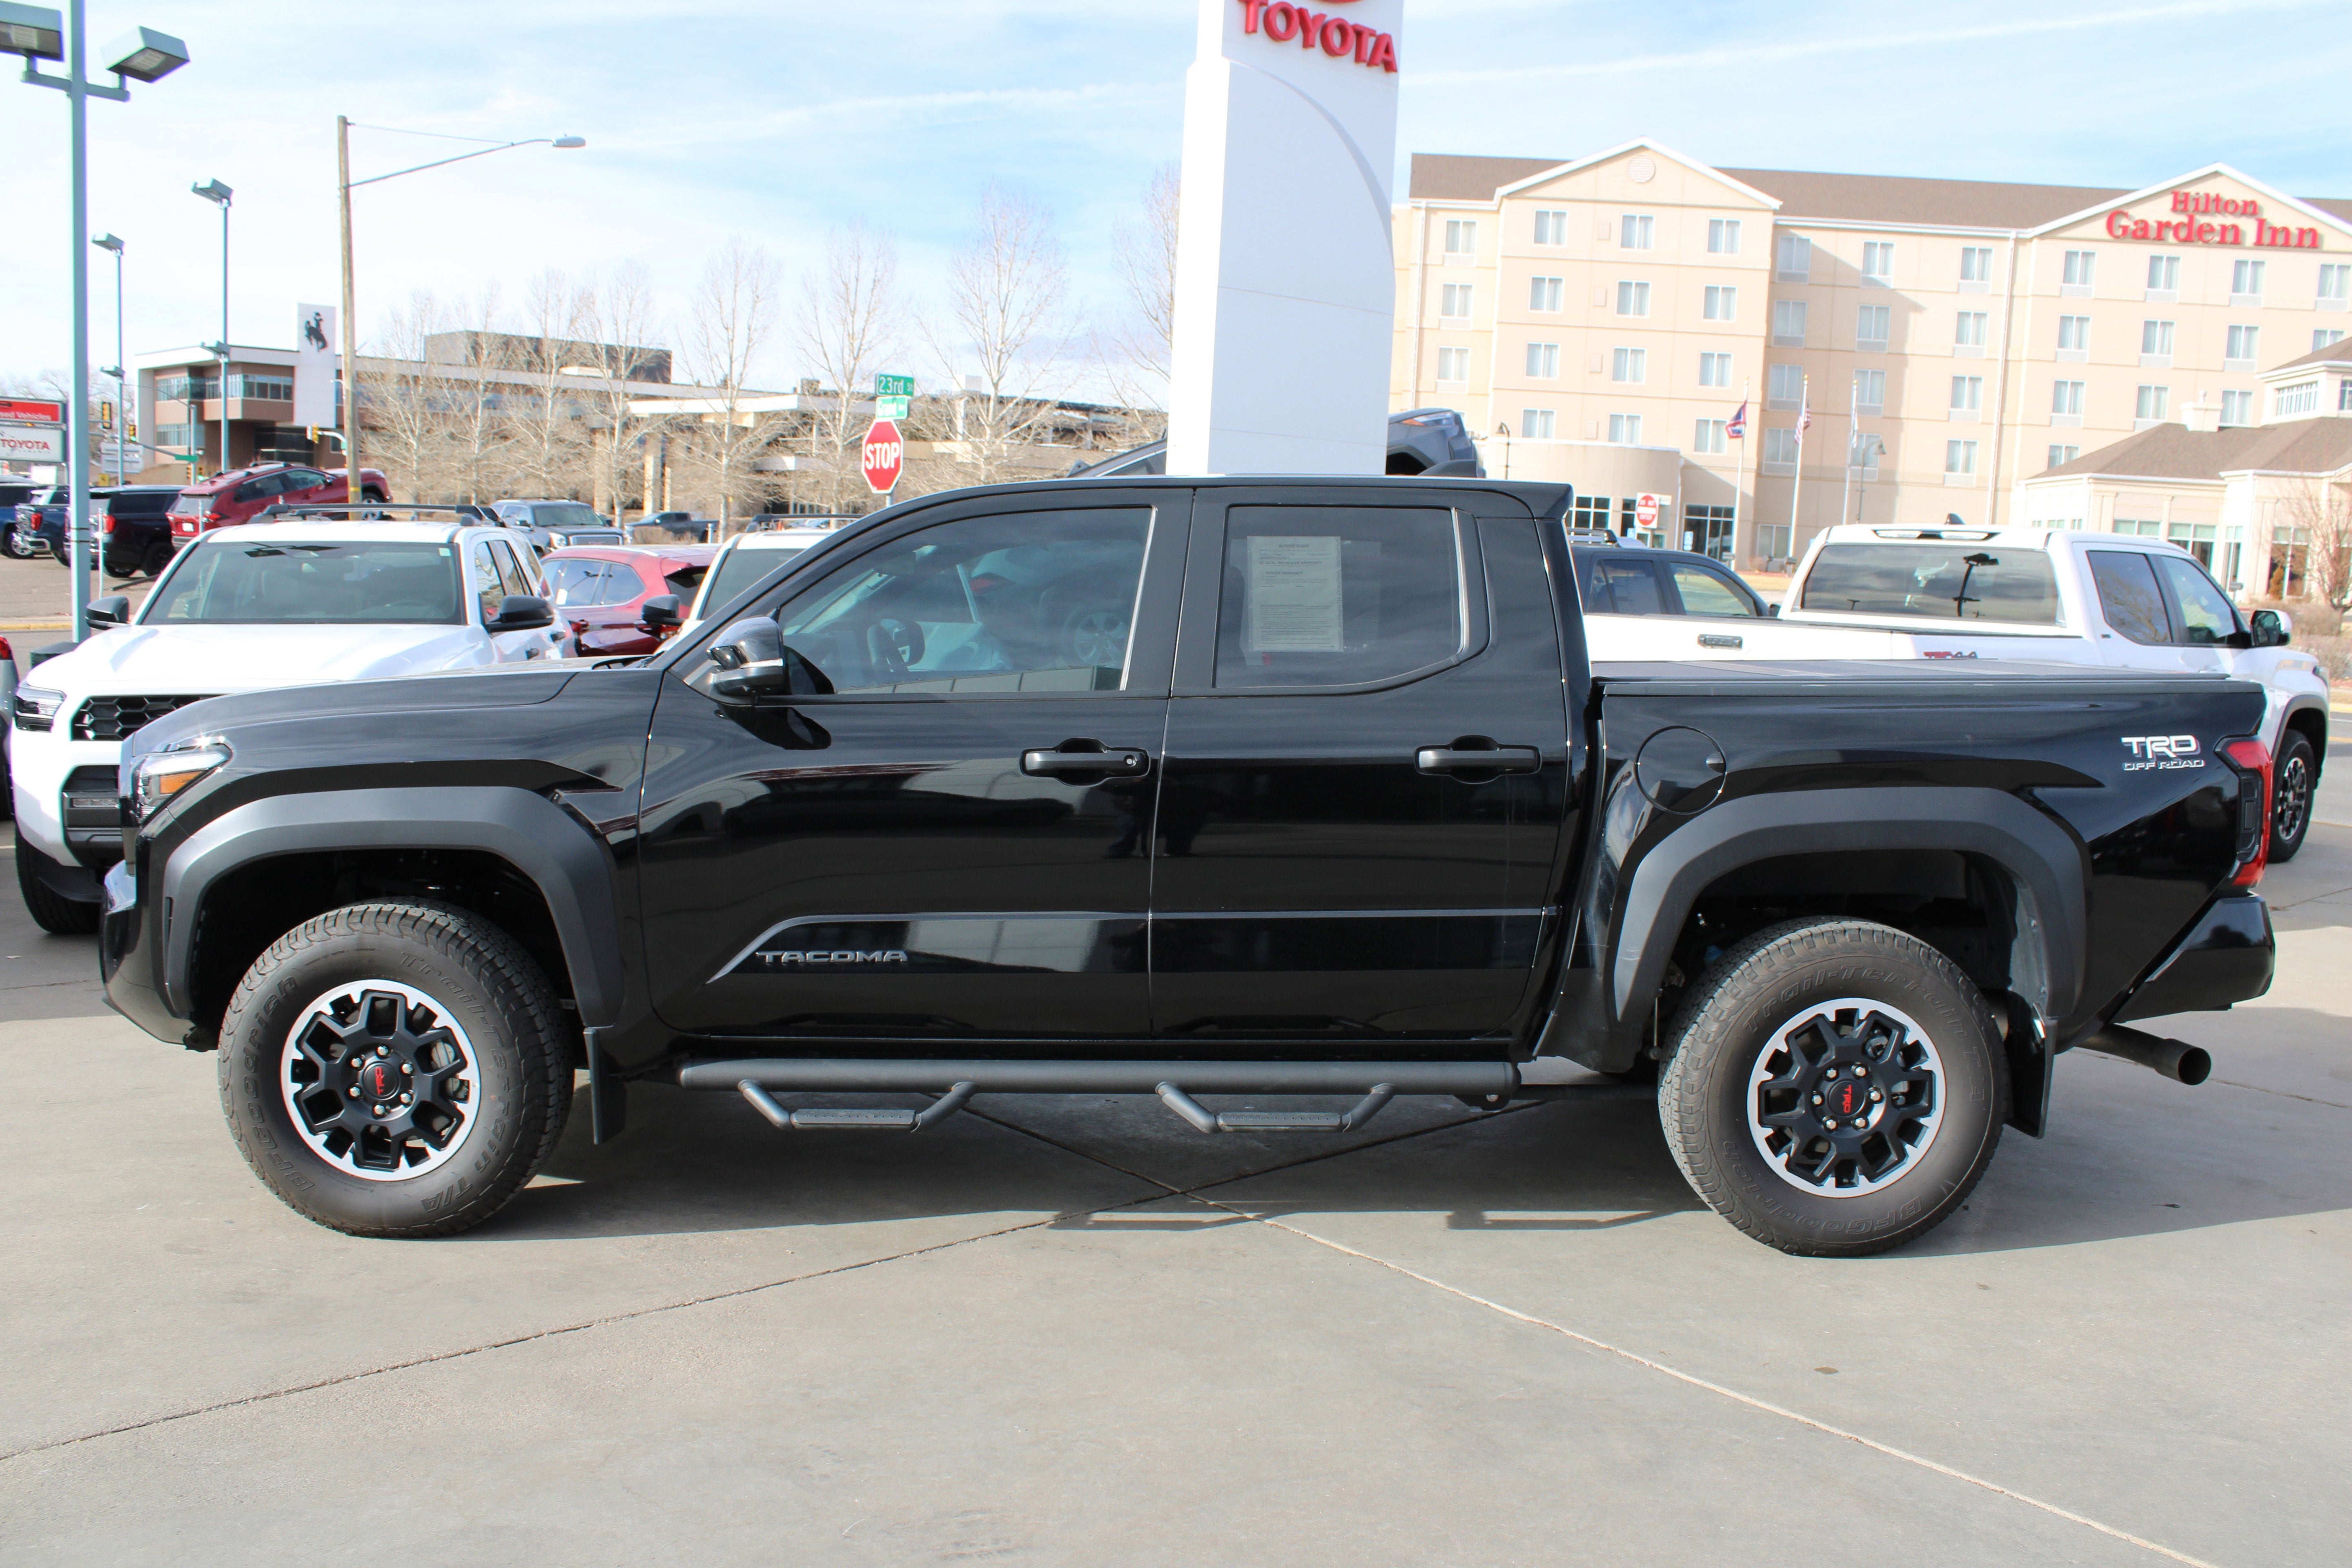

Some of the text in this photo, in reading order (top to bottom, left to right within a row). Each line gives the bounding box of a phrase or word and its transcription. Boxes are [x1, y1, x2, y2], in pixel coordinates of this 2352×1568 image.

[1238, 0, 1397, 73] TOYOTA
[2171, 190, 2259, 215] Hilton
[2106, 210, 2319, 249] Garden Inn
[879, 376, 913, 394] 23rd St
[877, 400, 897, 416] Grand
[0, 439, 50, 450] TOYOTA
[865, 442, 900, 470] STOP
[2121, 735, 2200, 760] TRD
[2123, 759, 2205, 771] OFF ROAD
[755, 950, 908, 963] TACOMA
[399, 951, 510, 1173] Trail-Terrain
[242, 975, 315, 1192] BFGoodrich
[375, 1067, 385, 1095] TRD
[1842, 1085, 1852, 1113] TRD
[1723, 1141, 1922, 1235] BFGoodrich
